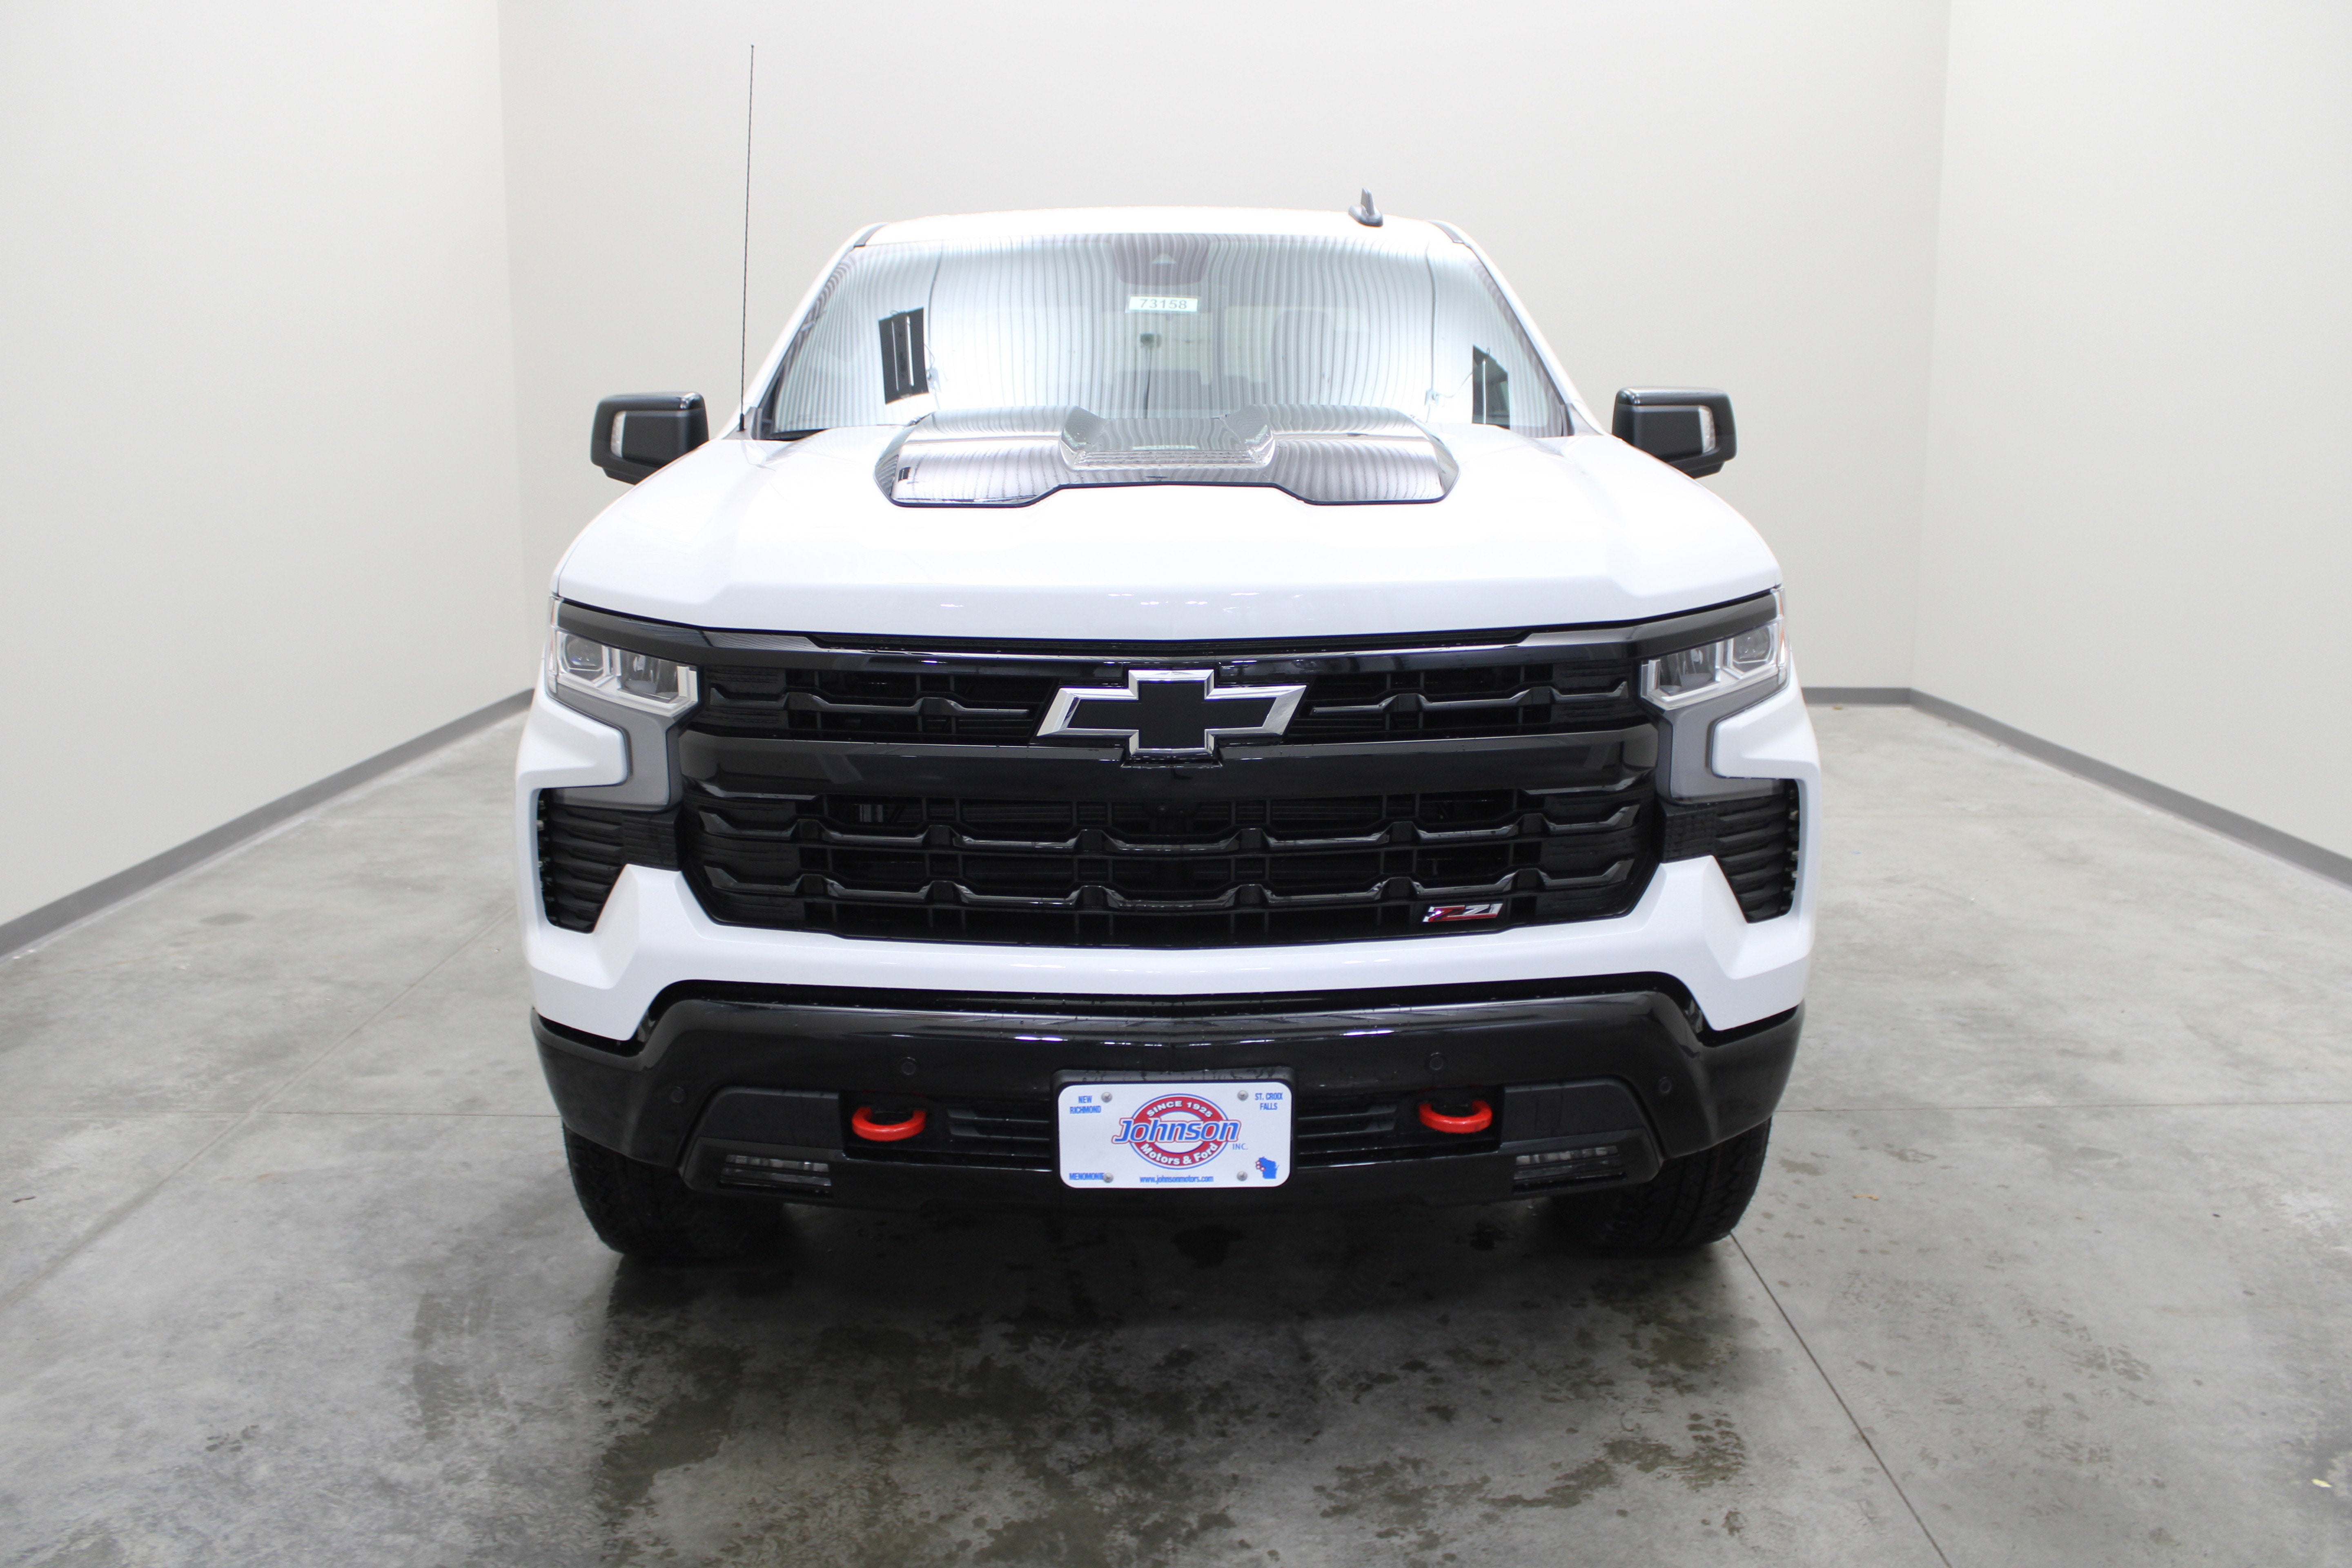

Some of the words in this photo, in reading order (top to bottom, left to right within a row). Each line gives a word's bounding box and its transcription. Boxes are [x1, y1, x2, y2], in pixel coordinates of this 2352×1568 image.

[1140, 298, 1187, 309] 73158
[1423, 903, 1503, 922] Z71
[1070, 1105, 1101, 1114] RICHMOND
[1146, 1100, 1183, 1117] SINCE
[1187, 1102, 1213, 1118] 1925
[1113, 1119, 1240, 1143] Johnson
[1140, 1143, 1180, 1165] Motors
[1183, 1155, 1192, 1165] &
[1193, 1143, 1219, 1162] Ford
[1140, 1175, 1214, 1184] www.johnsonmotors.com
